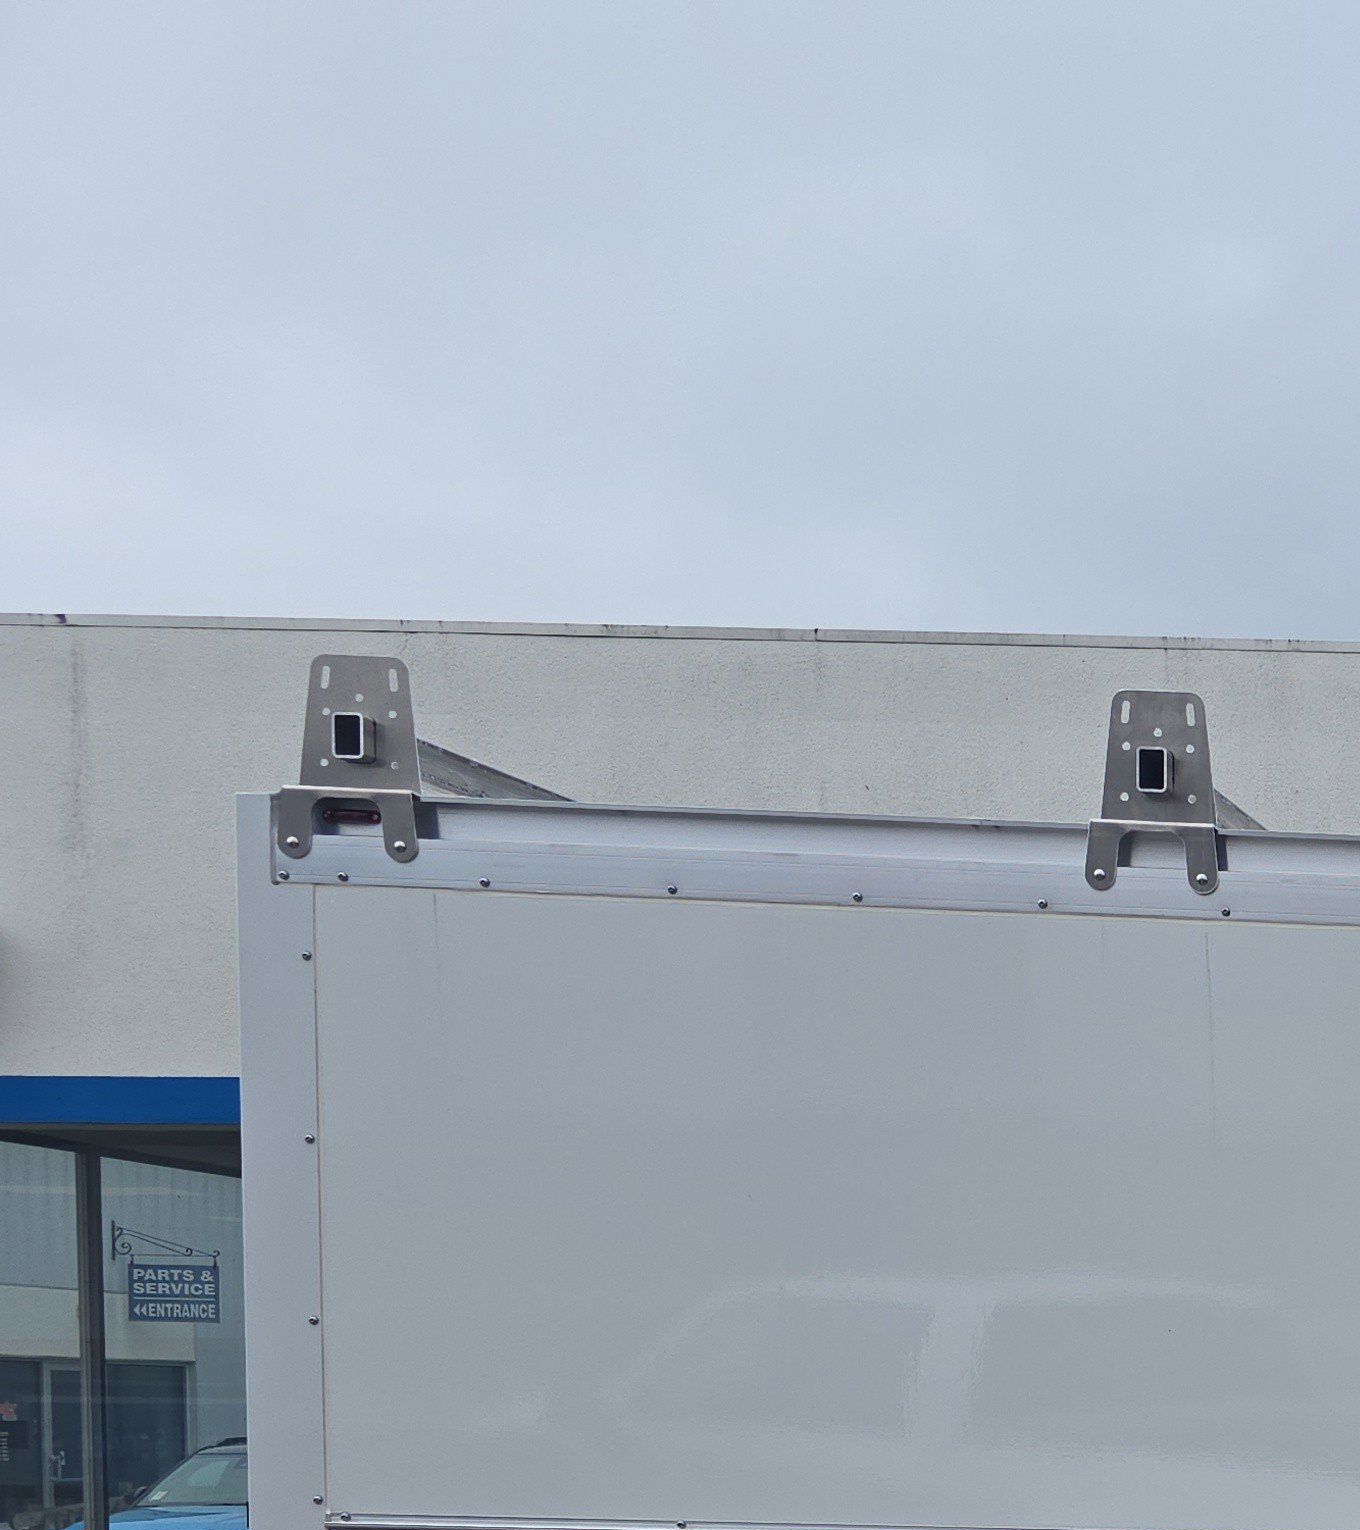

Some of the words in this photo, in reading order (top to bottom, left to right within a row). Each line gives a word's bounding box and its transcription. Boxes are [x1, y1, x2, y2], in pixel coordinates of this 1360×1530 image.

[132, 1268, 195, 1281] PARTS
[200, 1270, 214, 1281] &
[132, 1282, 216, 1295] SERVICE
[148, 1302, 216, 1319] ENTRANCE
